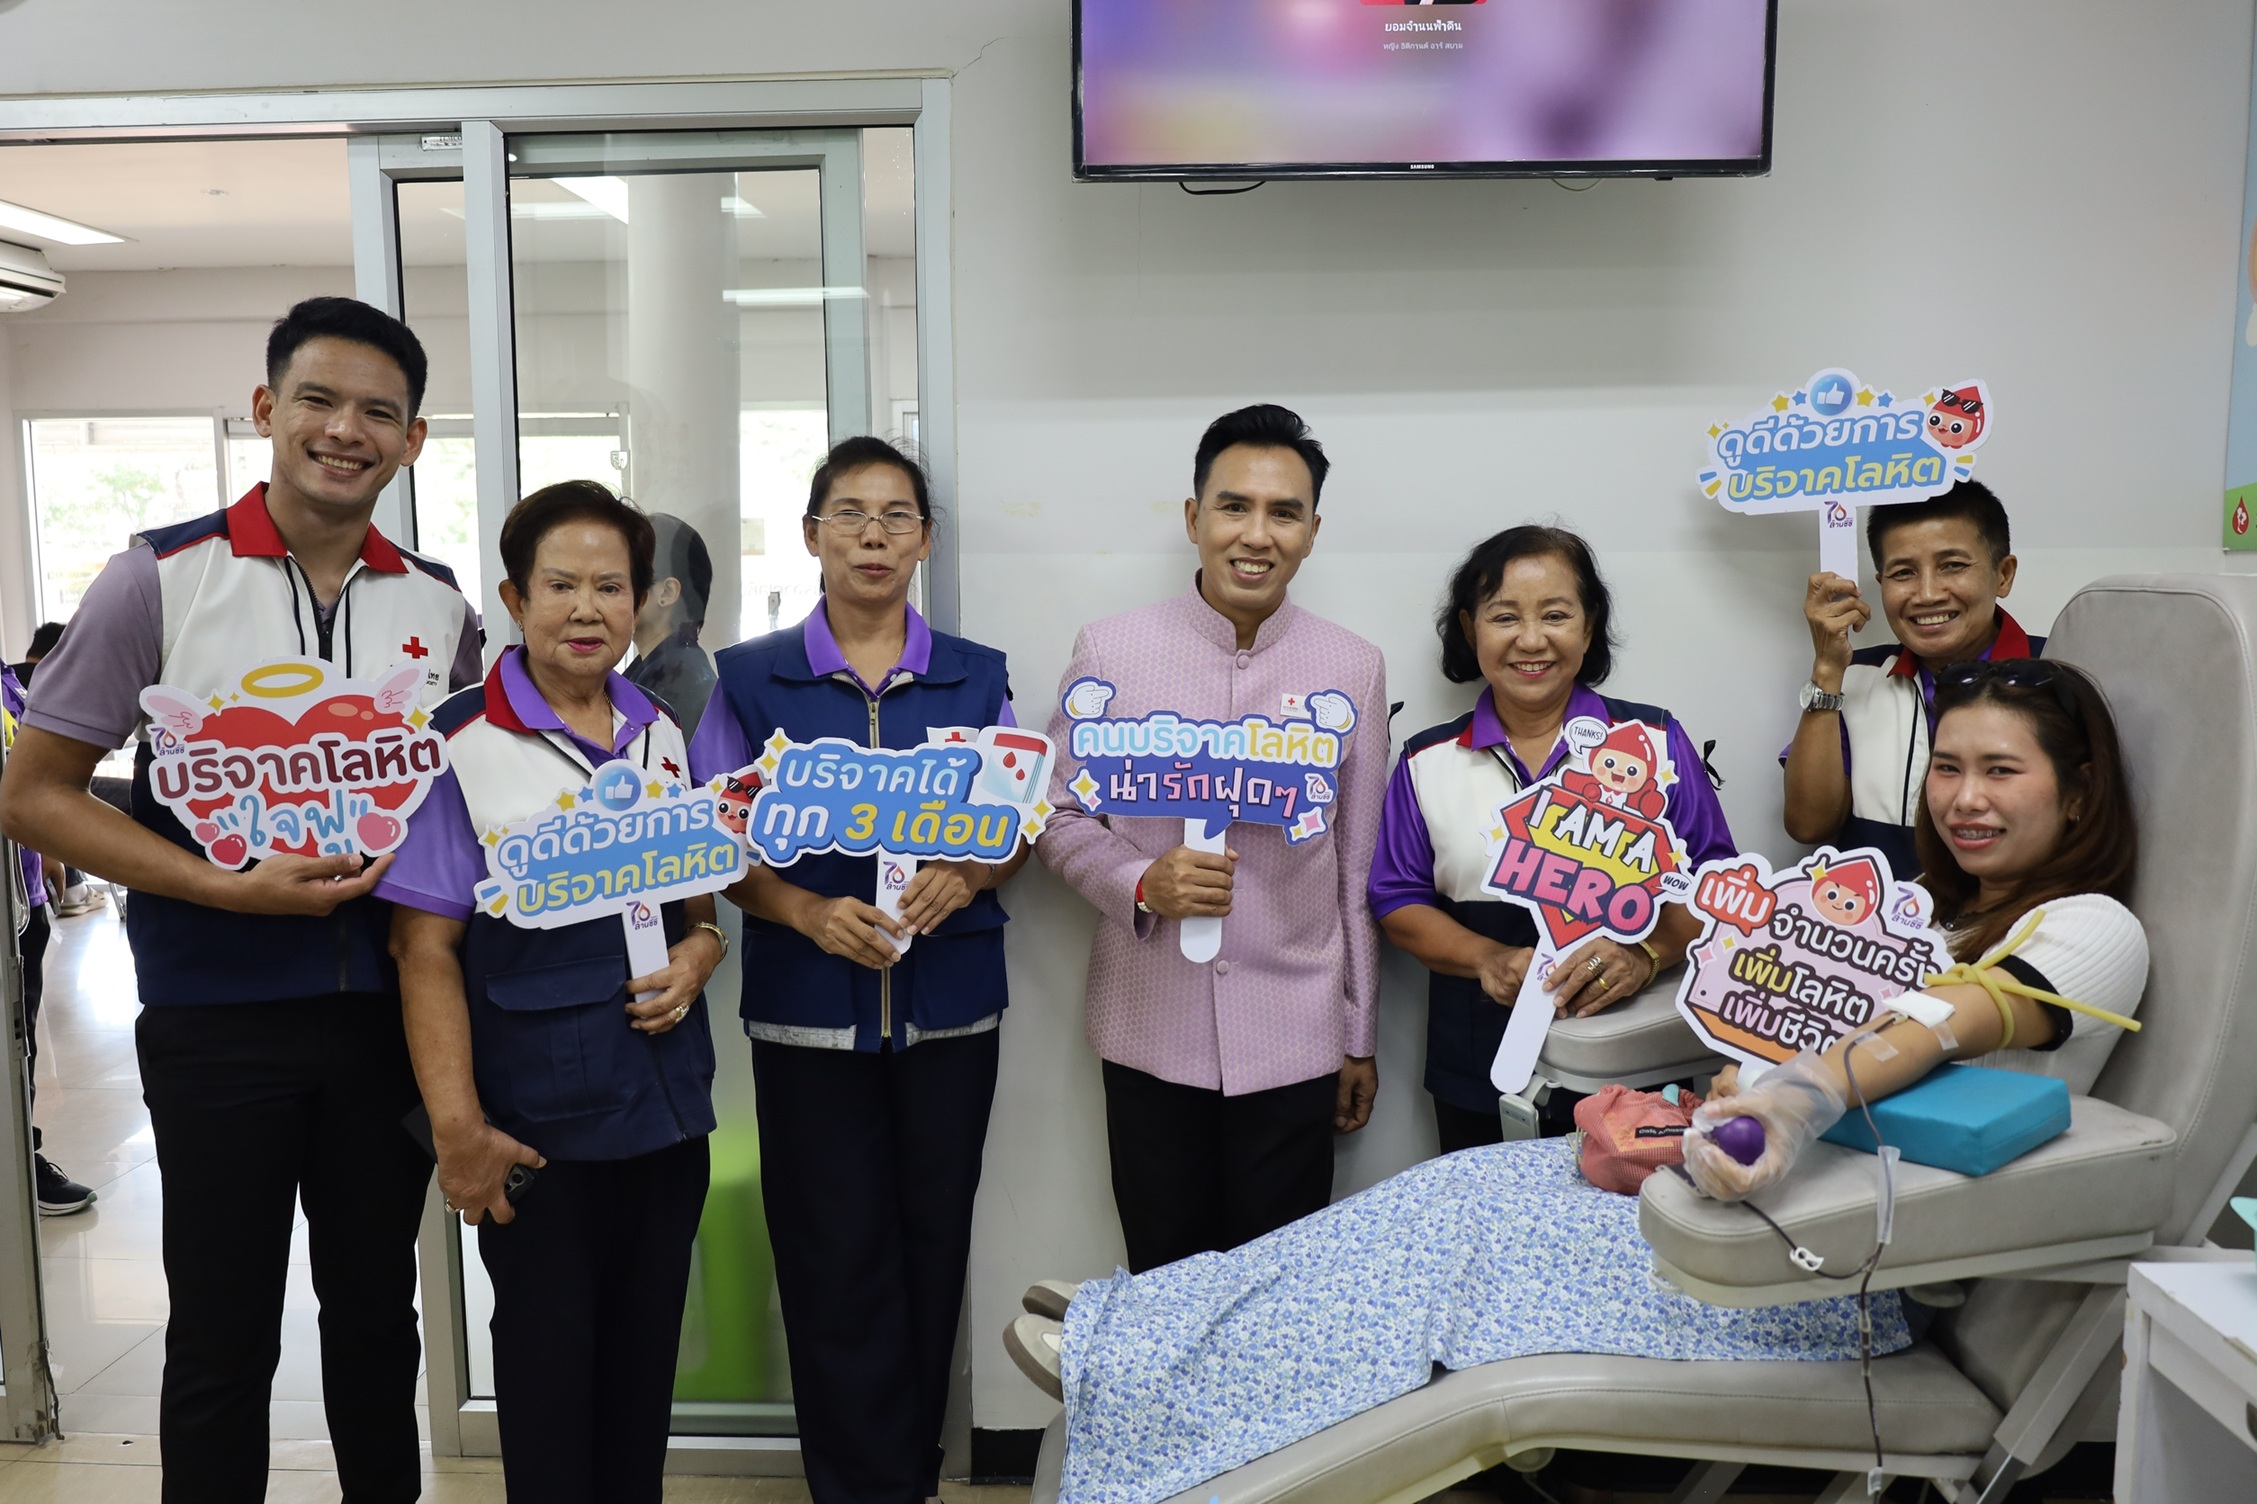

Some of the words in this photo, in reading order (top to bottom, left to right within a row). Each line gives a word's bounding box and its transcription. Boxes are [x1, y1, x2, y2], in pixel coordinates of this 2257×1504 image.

[1385, 19, 1462, 32] ยอมจำนนฟ้าดิน
[1718, 411, 1921, 467] ดูดีด้วยการ
[1729, 453, 1941, 499] บริจาคโลหิต
[1077, 719, 1334, 763] คนบริจาคโลหิต
[1574, 726, 1604, 740] THANKS!
[157, 735, 441, 799] บริจาคโลหิต
[785, 753, 967, 796] บริจาคได้
[1110, 759, 1298, 818] น่ารักฝุดๆ
[500, 800, 711, 874] ดูดีด้วยการ
[763, 802, 830, 851] ทุก
[845, 802, 878, 841] 3
[891, 799, 1009, 848] เดือน
[1528, 787, 1552, 829] I
[1554, 803, 1618, 860] AM
[1622, 830, 1658, 873] A
[518, 841, 734, 913] บริจาคโลหิต
[1493, 840, 1654, 932] HERO
[1663, 875, 1689, 890] WOW
[1700, 870, 1770, 922] เพิ่ม
[1734, 948, 1868, 1024] เพิ่มโลหิต
